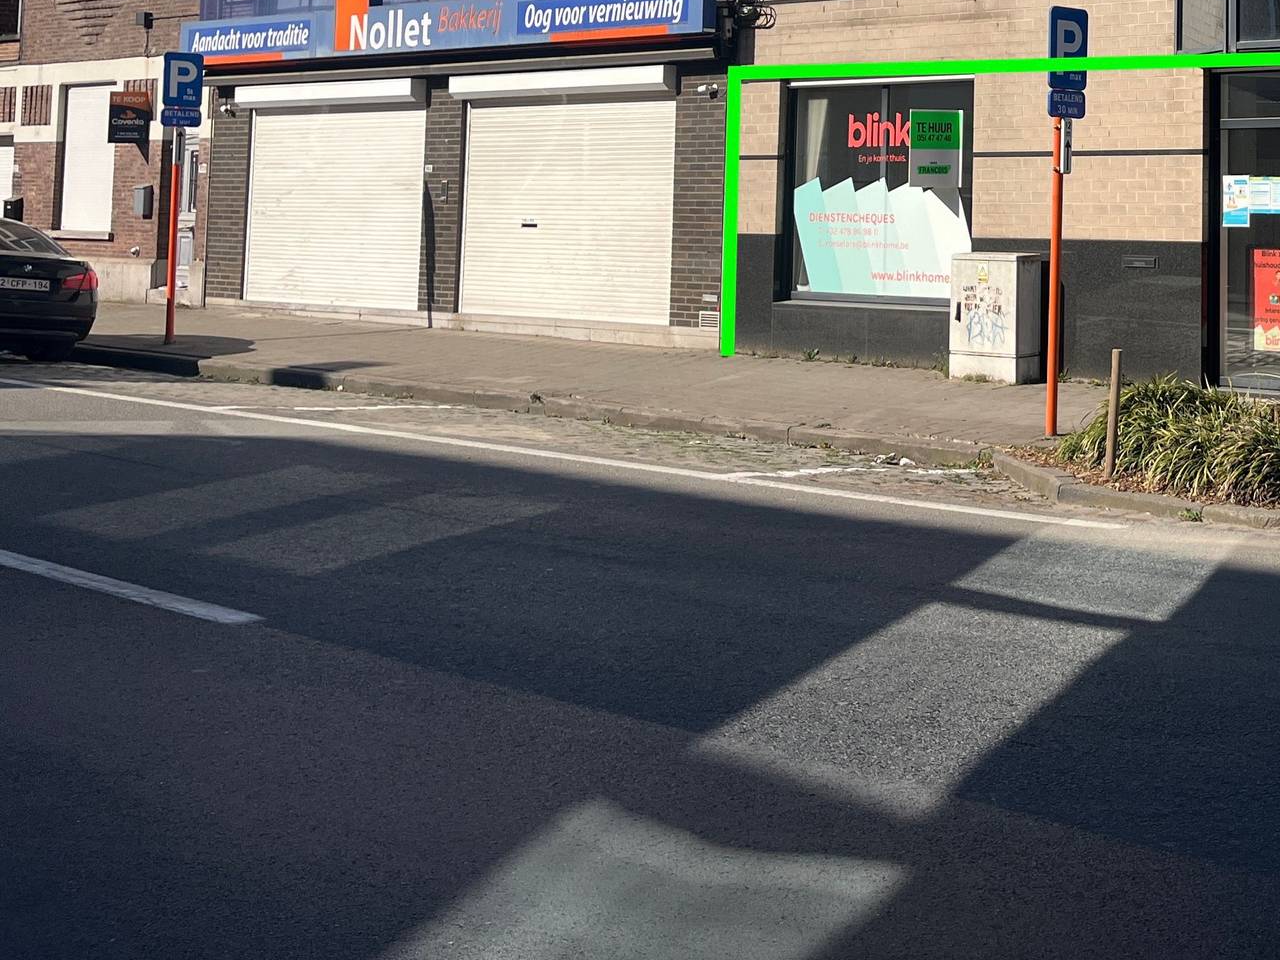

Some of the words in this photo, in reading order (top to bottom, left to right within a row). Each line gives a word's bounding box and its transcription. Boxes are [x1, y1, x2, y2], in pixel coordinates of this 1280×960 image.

[349, 9, 432, 51] Nollet
[437, 0, 503, 36] Bakkerij
[524, 3, 552, 33] Oog
[555, 5, 587, 26] voor
[191, 28, 240, 53] Aandacht
[242, 31, 266, 49] voor
[267, 23, 309, 47] traditie
[1056, 19, 1083, 76] P
[169, 60, 198, 98] P
[1053, 93, 1083, 103] BETALEND
[1057, 104, 1066, 114] 30
[165, 110, 200, 118] BETALEND
[916, 122, 927, 133] TE
[928, 122, 952, 133] HUUR
[848, 112, 910, 148] blink
[809, 212, 895, 224] DIENSTENCHEQUES
